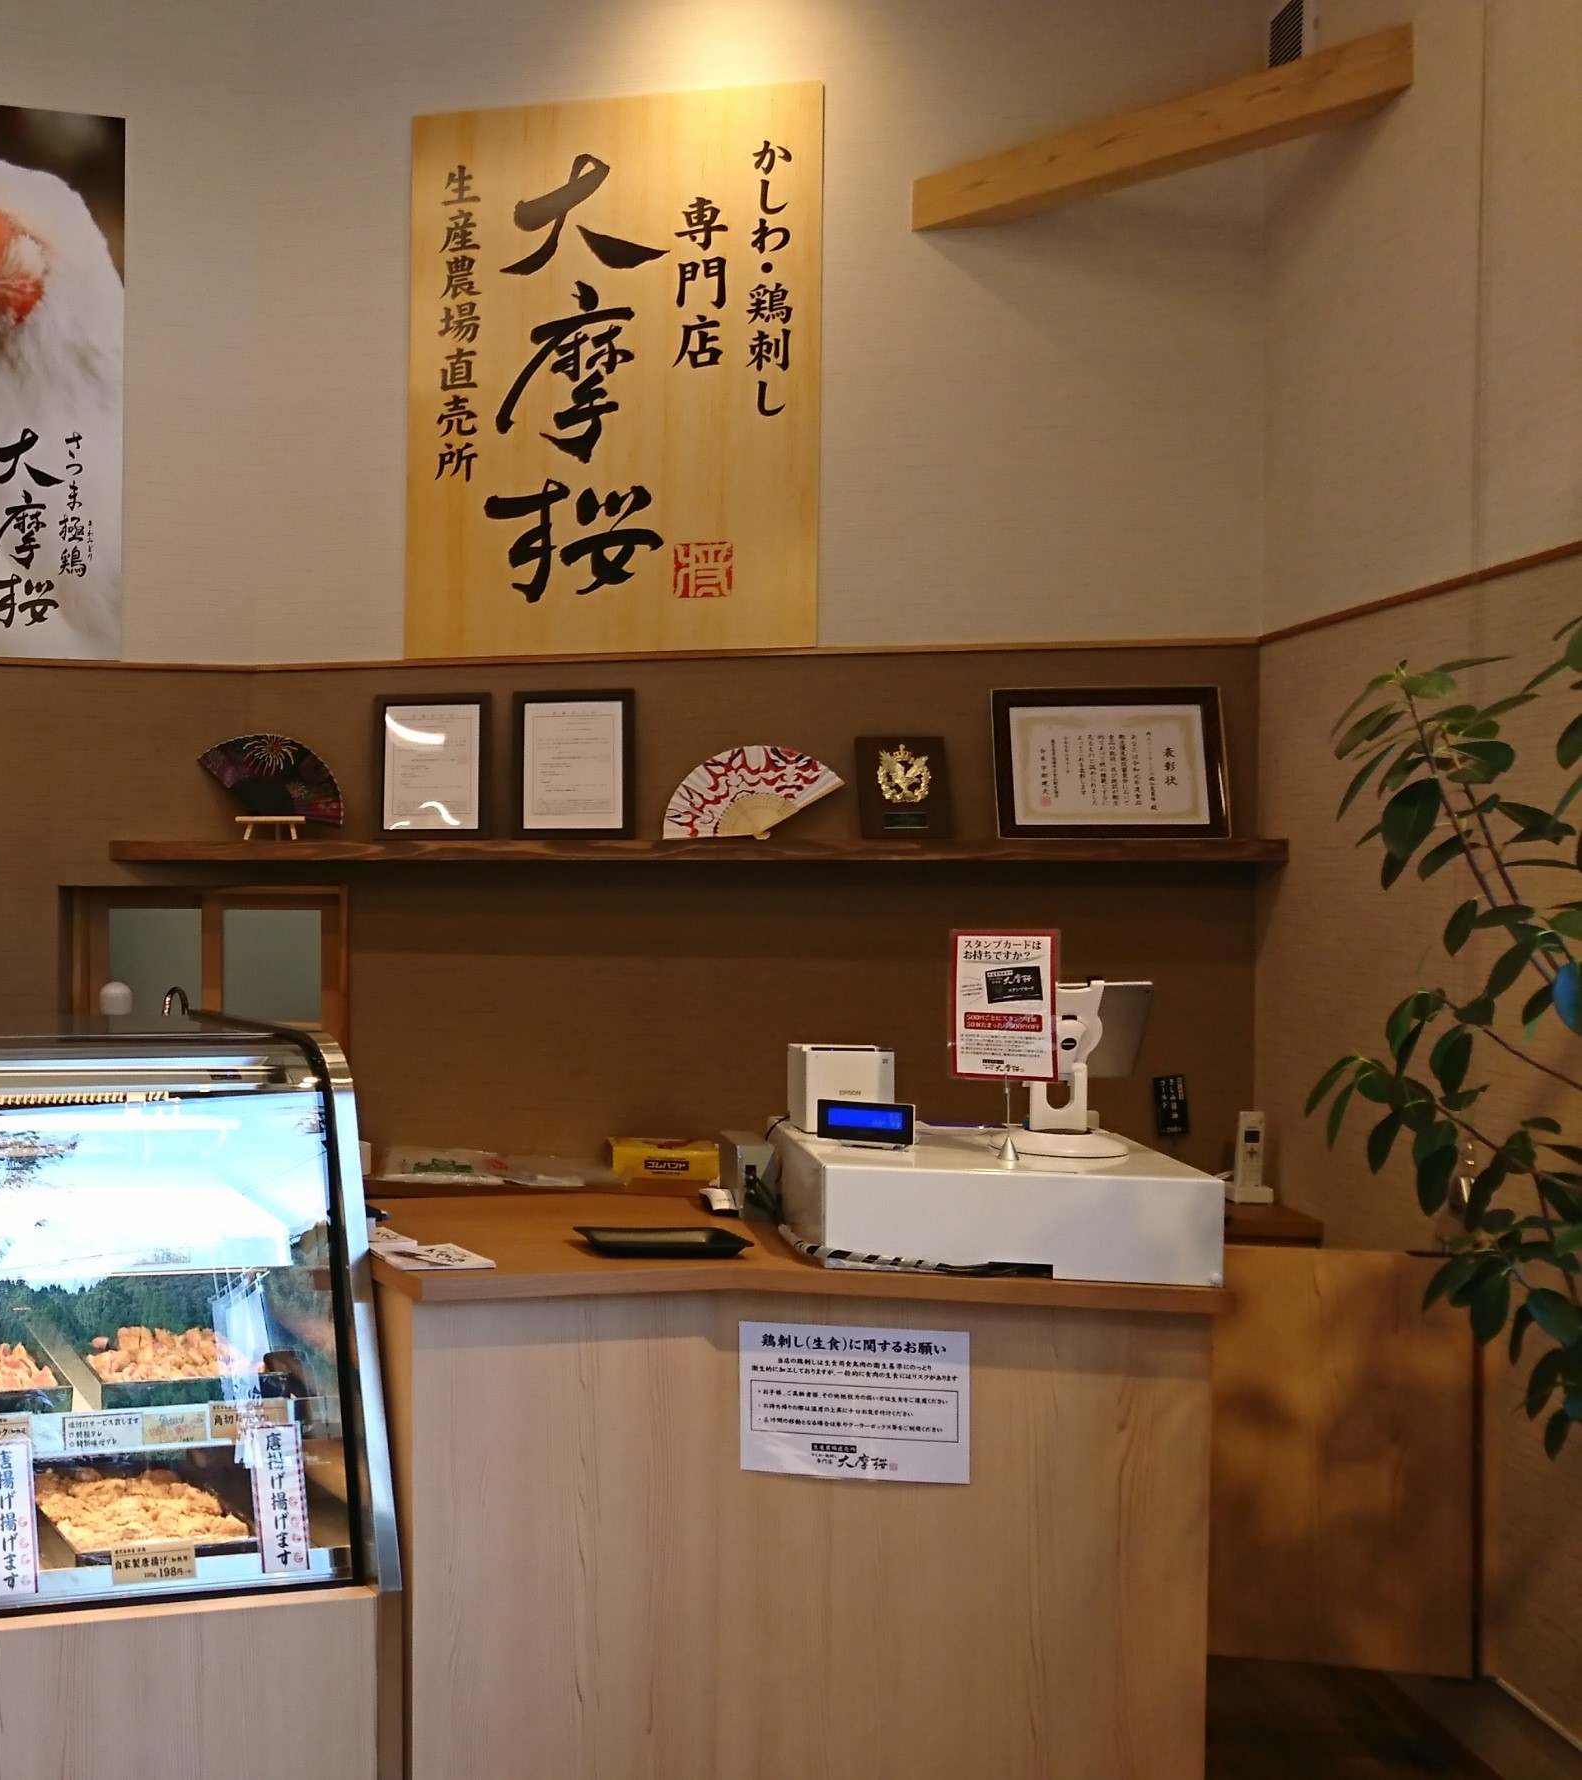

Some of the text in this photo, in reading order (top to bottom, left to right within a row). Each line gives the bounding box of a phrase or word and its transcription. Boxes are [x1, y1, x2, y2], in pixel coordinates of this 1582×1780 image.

[434, 164, 482, 483] 生産農場直売所
[671, 196, 730, 370] 専門店
[745, 139, 794, 419] かしわ・鶏刺し
[484, 153, 670, 602] 大摩桜
[58, 431, 87, 578] さつま極鶏
[1162, 746, 1178, 786] 表彰状
[962, 950, 1031, 961] お持ちですか?
[963, 940, 1042, 950] スタンプカードは
[761, 1332, 947, 1356] 鶏刺し(生食)に関するお願い
[265, 1432, 291, 1568] 唐揚げ揚げます
[838, 1453, 888, 1470] 大摩桜
